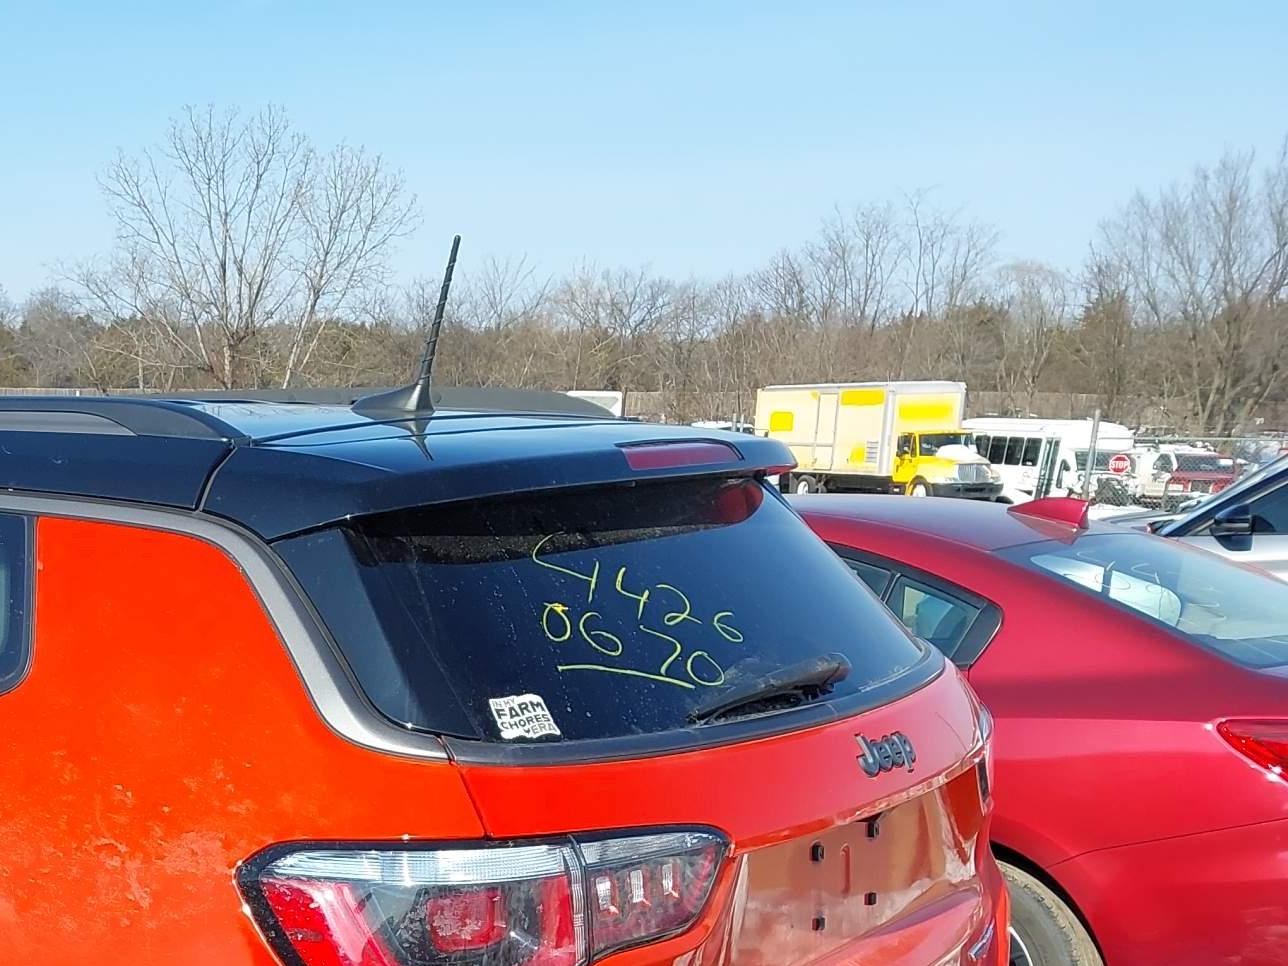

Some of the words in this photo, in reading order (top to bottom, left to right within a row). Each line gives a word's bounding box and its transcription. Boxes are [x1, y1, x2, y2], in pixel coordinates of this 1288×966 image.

[1110, 460, 1129, 469] STOP
[495, 701, 546, 720] FARM
[500, 714, 551, 730] CHORES
[532, 722, 558, 734] ERA
[854, 731, 916, 778] Jeep
